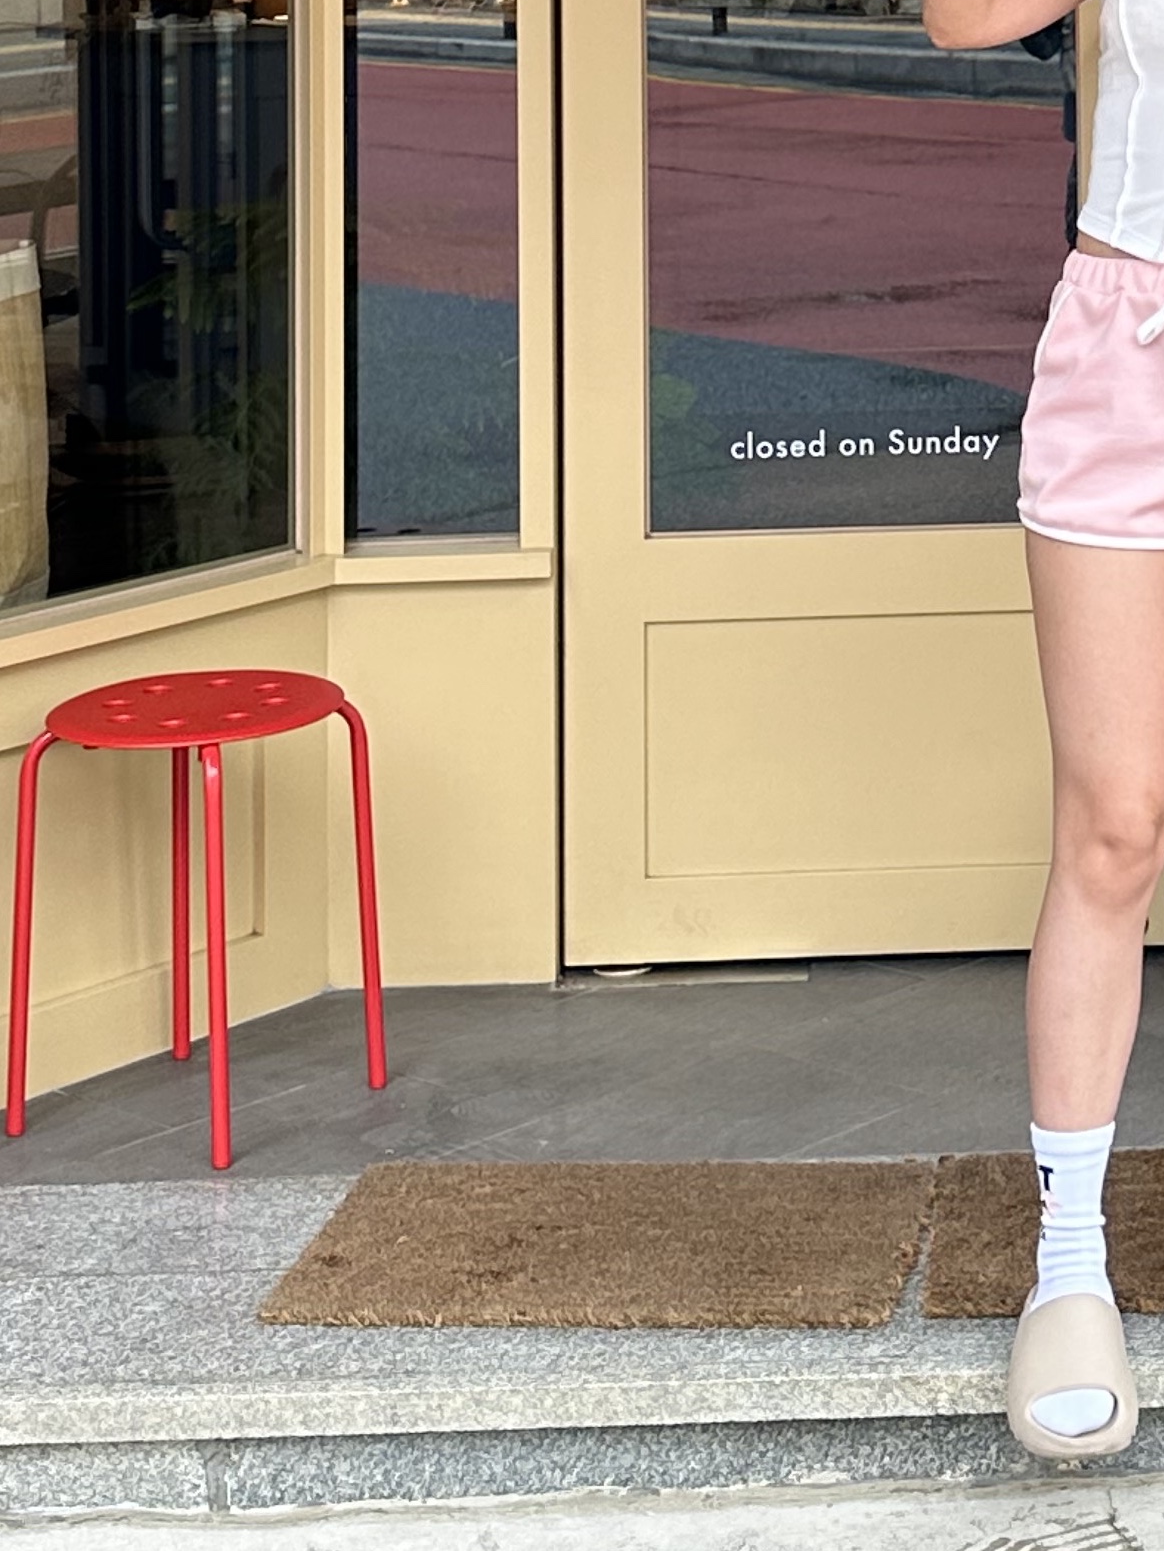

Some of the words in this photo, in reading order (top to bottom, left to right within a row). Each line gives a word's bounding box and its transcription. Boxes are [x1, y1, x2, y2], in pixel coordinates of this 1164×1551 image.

[730, 428, 827, 460] closed
[838, 437, 875, 457] on
[888, 425, 1000, 460] Sunday
